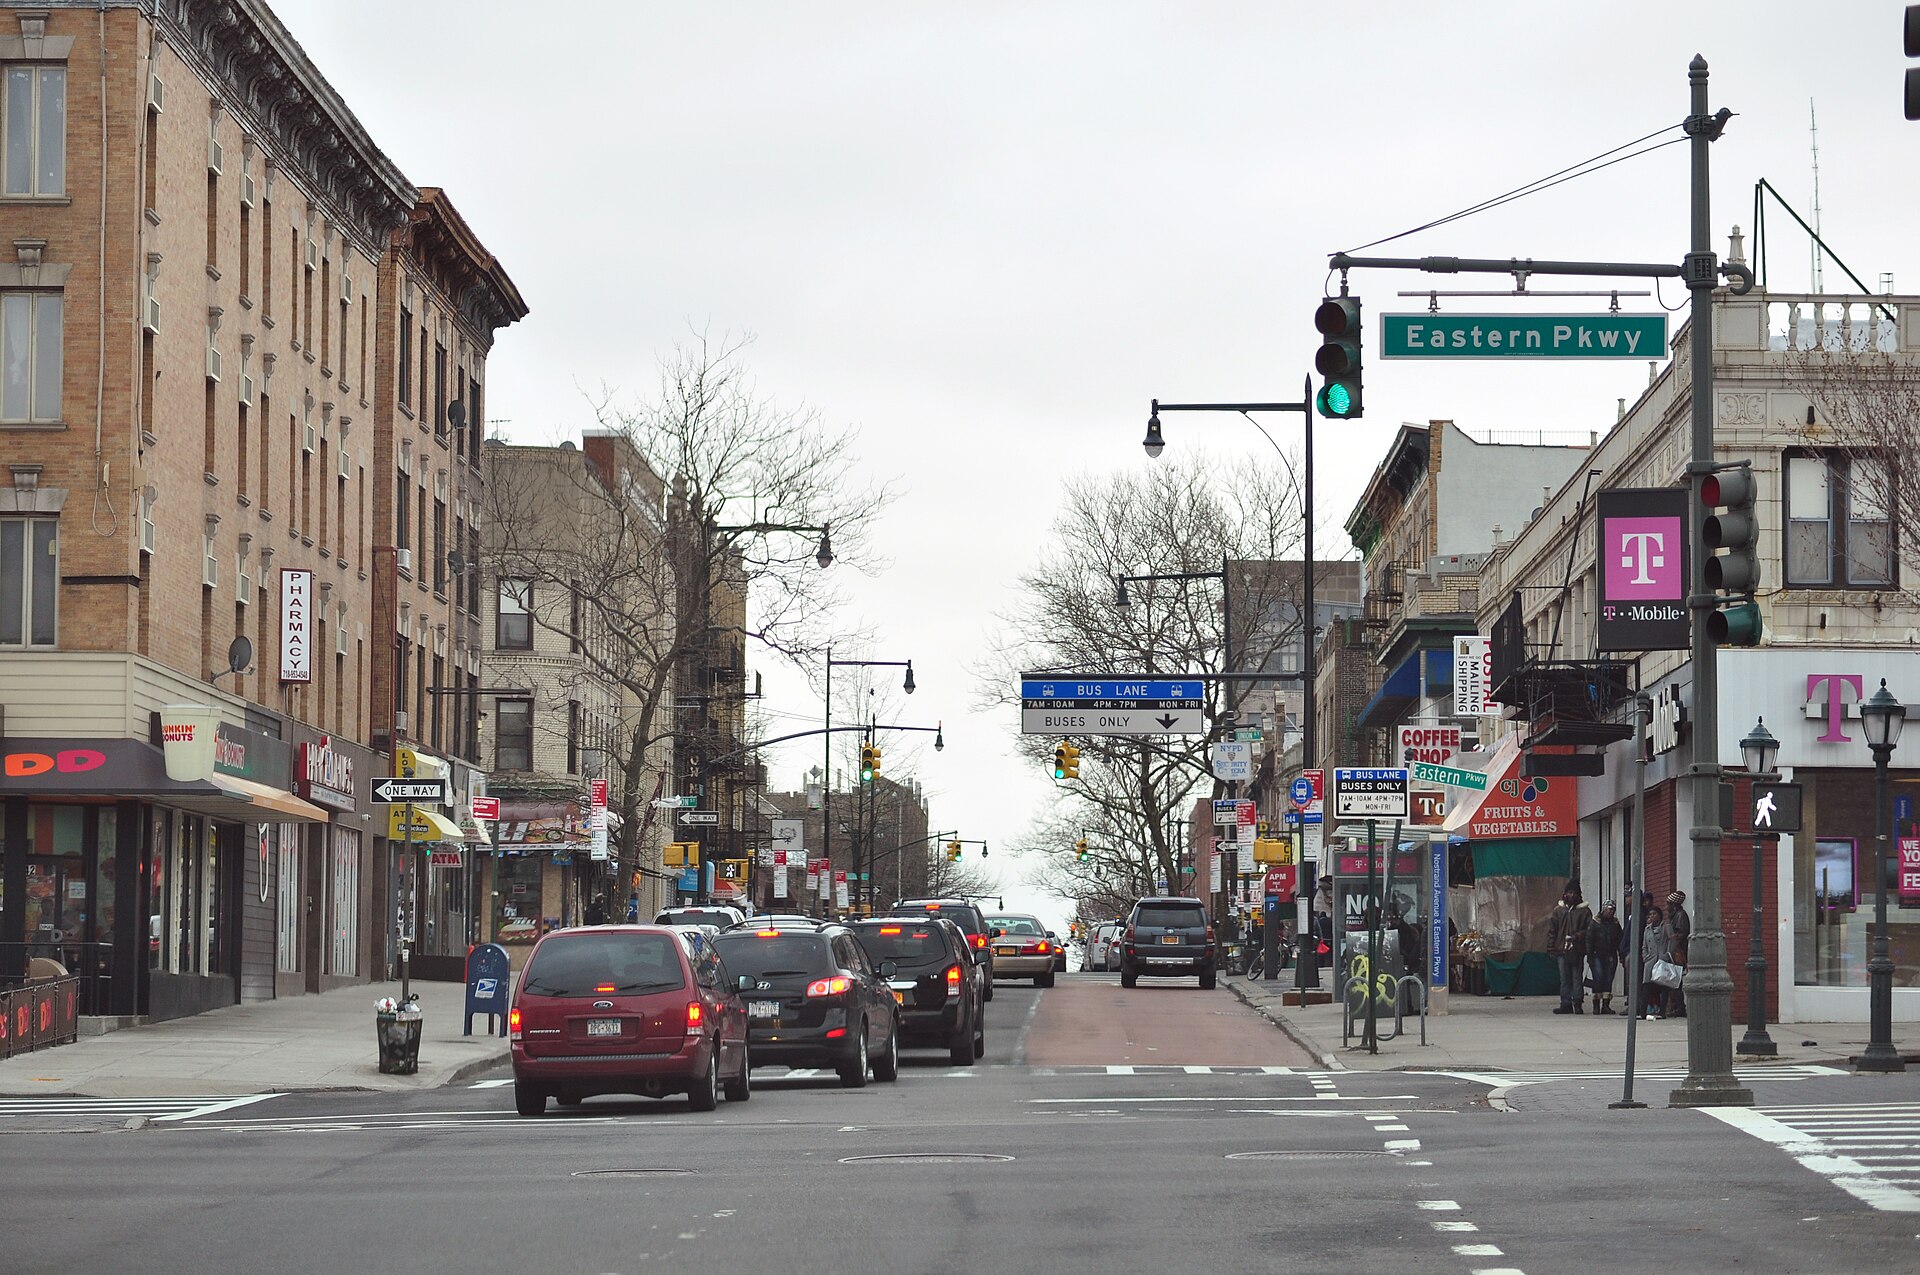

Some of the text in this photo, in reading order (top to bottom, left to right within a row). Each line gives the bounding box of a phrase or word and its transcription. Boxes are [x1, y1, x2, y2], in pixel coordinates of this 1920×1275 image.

[1407, 325, 1642, 353] Eastern Pkwy
[289, 573, 303, 669] PHARMACY
[1077, 685, 1148, 696] BUS LANE
[1458, 661, 1467, 712] SHIPPING
[1470, 661, 1479, 712] MAILING
[1045, 717, 1130, 727] BUSES ONLY
[1401, 729, 1460, 746] COFFEE
[1356, 771, 1401, 779] BUS LANE
[1413, 764, 1486, 785] Eastern Pkwy
[385, 786, 435, 796] ONE WAY
[1341, 782, 1402, 790] BUSES ONLY
[1484, 806, 1545, 819] FRUITS &
[1473, 821, 1557, 835] VEGETABLES
[432, 853, 461, 864] ATM
[1269, 903, 1275, 911] P
[1432, 854, 1441, 977] Nostrand Avenue & Eastern Pkwy
